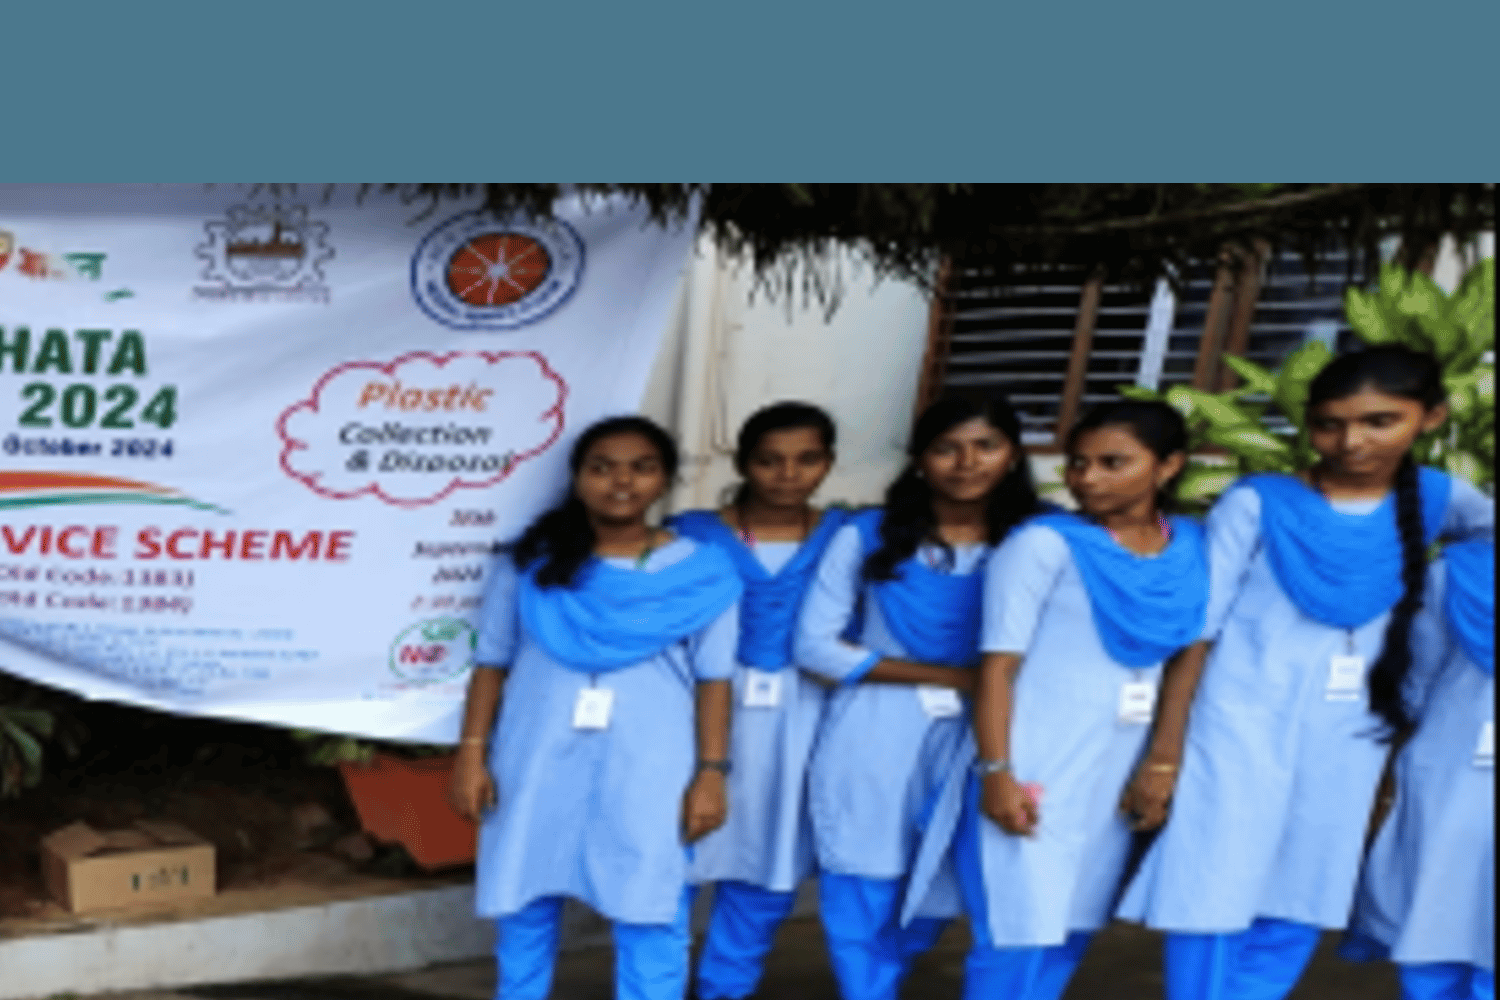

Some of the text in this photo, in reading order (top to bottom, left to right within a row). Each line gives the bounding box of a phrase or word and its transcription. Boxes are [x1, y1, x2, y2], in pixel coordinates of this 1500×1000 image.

[18, 381, 179, 430] 2024
[357, 380, 494, 412] Plastic
[2, 434, 103, 458] October
[110, 436, 176, 459] 2024
[338, 421, 493, 447] Collection
[133, 524, 357, 563] SCHEME
